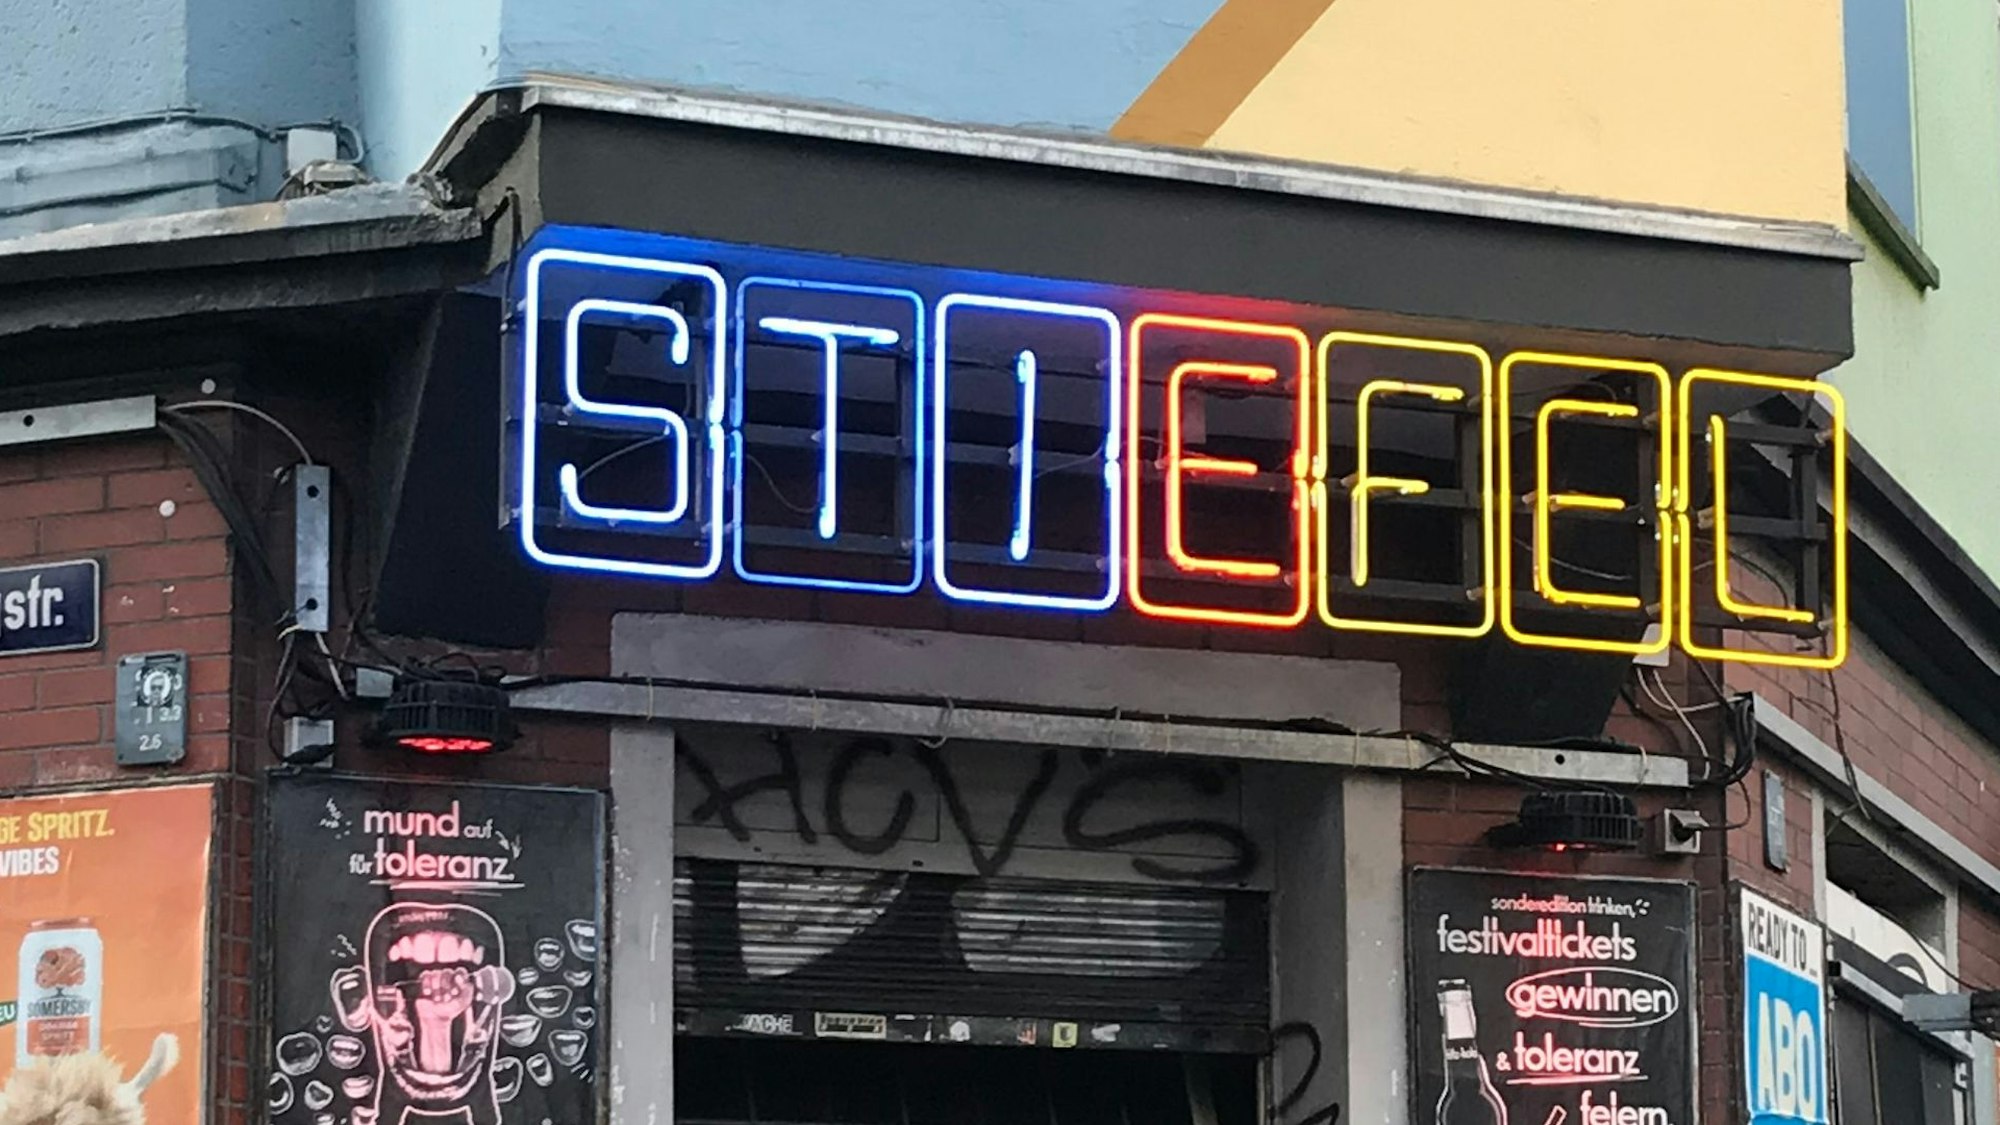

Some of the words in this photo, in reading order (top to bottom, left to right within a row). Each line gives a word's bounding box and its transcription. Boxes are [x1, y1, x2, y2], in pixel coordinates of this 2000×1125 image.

[563, 298, 1815, 622] STIEFEL
[0, 574, 64, 631] str.
[27, 808, 116, 843] SPRITZ.
[364, 799, 460, 838] mund
[463, 818, 493, 839] auf
[349, 853, 373, 875] für
[1491, 893, 1586, 914] sonderedition
[1436, 914, 1638, 962] festivaltickets
[1748, 902, 1788, 963] READY
[1512, 972, 1674, 1018] gewinnen
[1496, 1051, 1512, 1071] &
[1514, 1031, 1641, 1074] toleranz
[1757, 991, 1817, 1121] ABO
